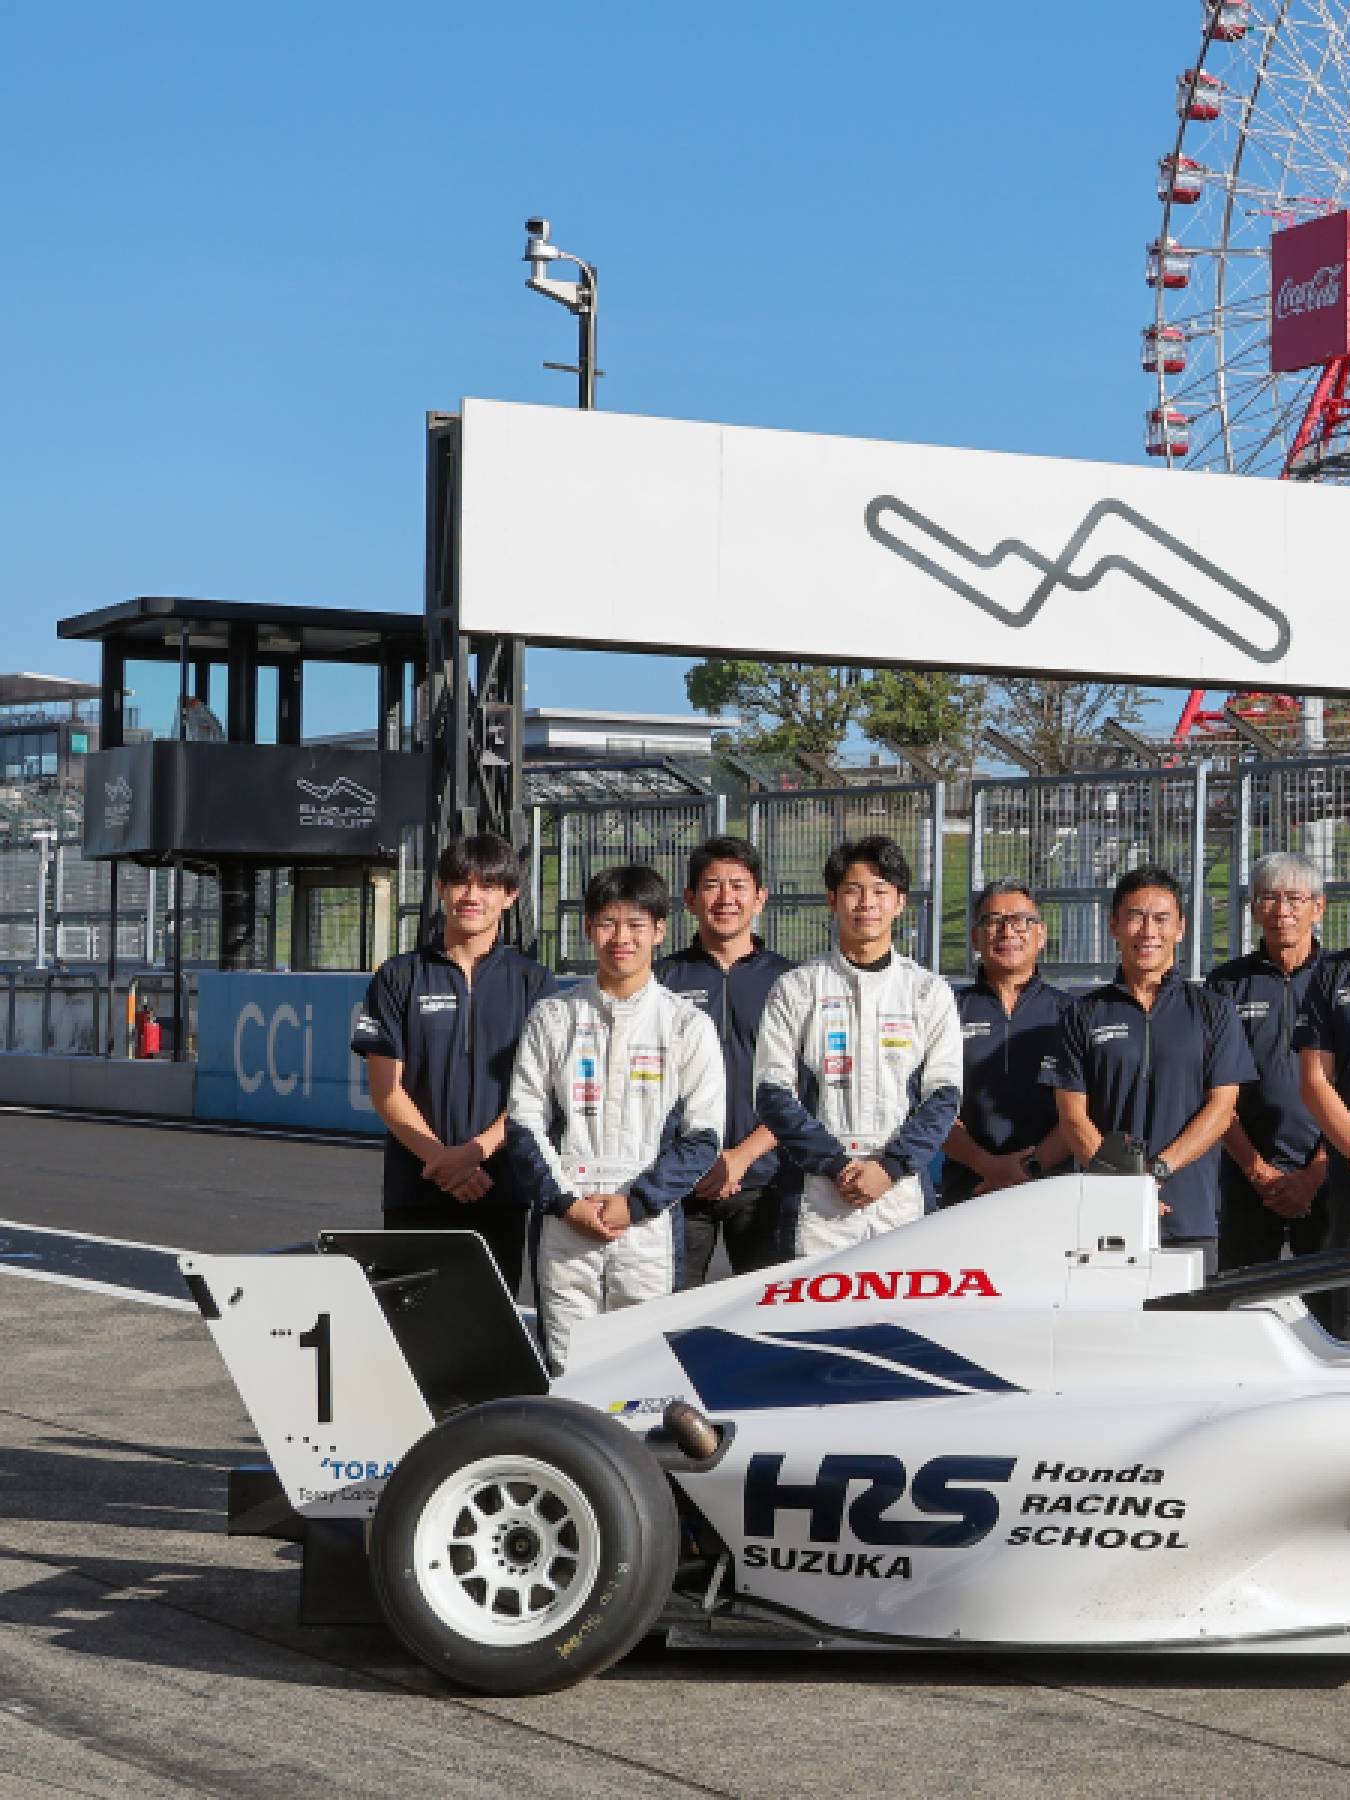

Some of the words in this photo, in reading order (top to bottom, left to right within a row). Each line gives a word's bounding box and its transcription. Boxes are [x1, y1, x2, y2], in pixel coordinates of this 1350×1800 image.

[757, 1269, 1002, 1305] HONDA
[299, 1312, 333, 1424] 1
[1032, 1460, 1165, 1484] Honda
[743, 1452, 1018, 1548] HRS
[1020, 1493, 1187, 1519] RACING
[1004, 1525, 1189, 1549] SCHOOL
[743, 1544, 912, 1579] SUZUKA
